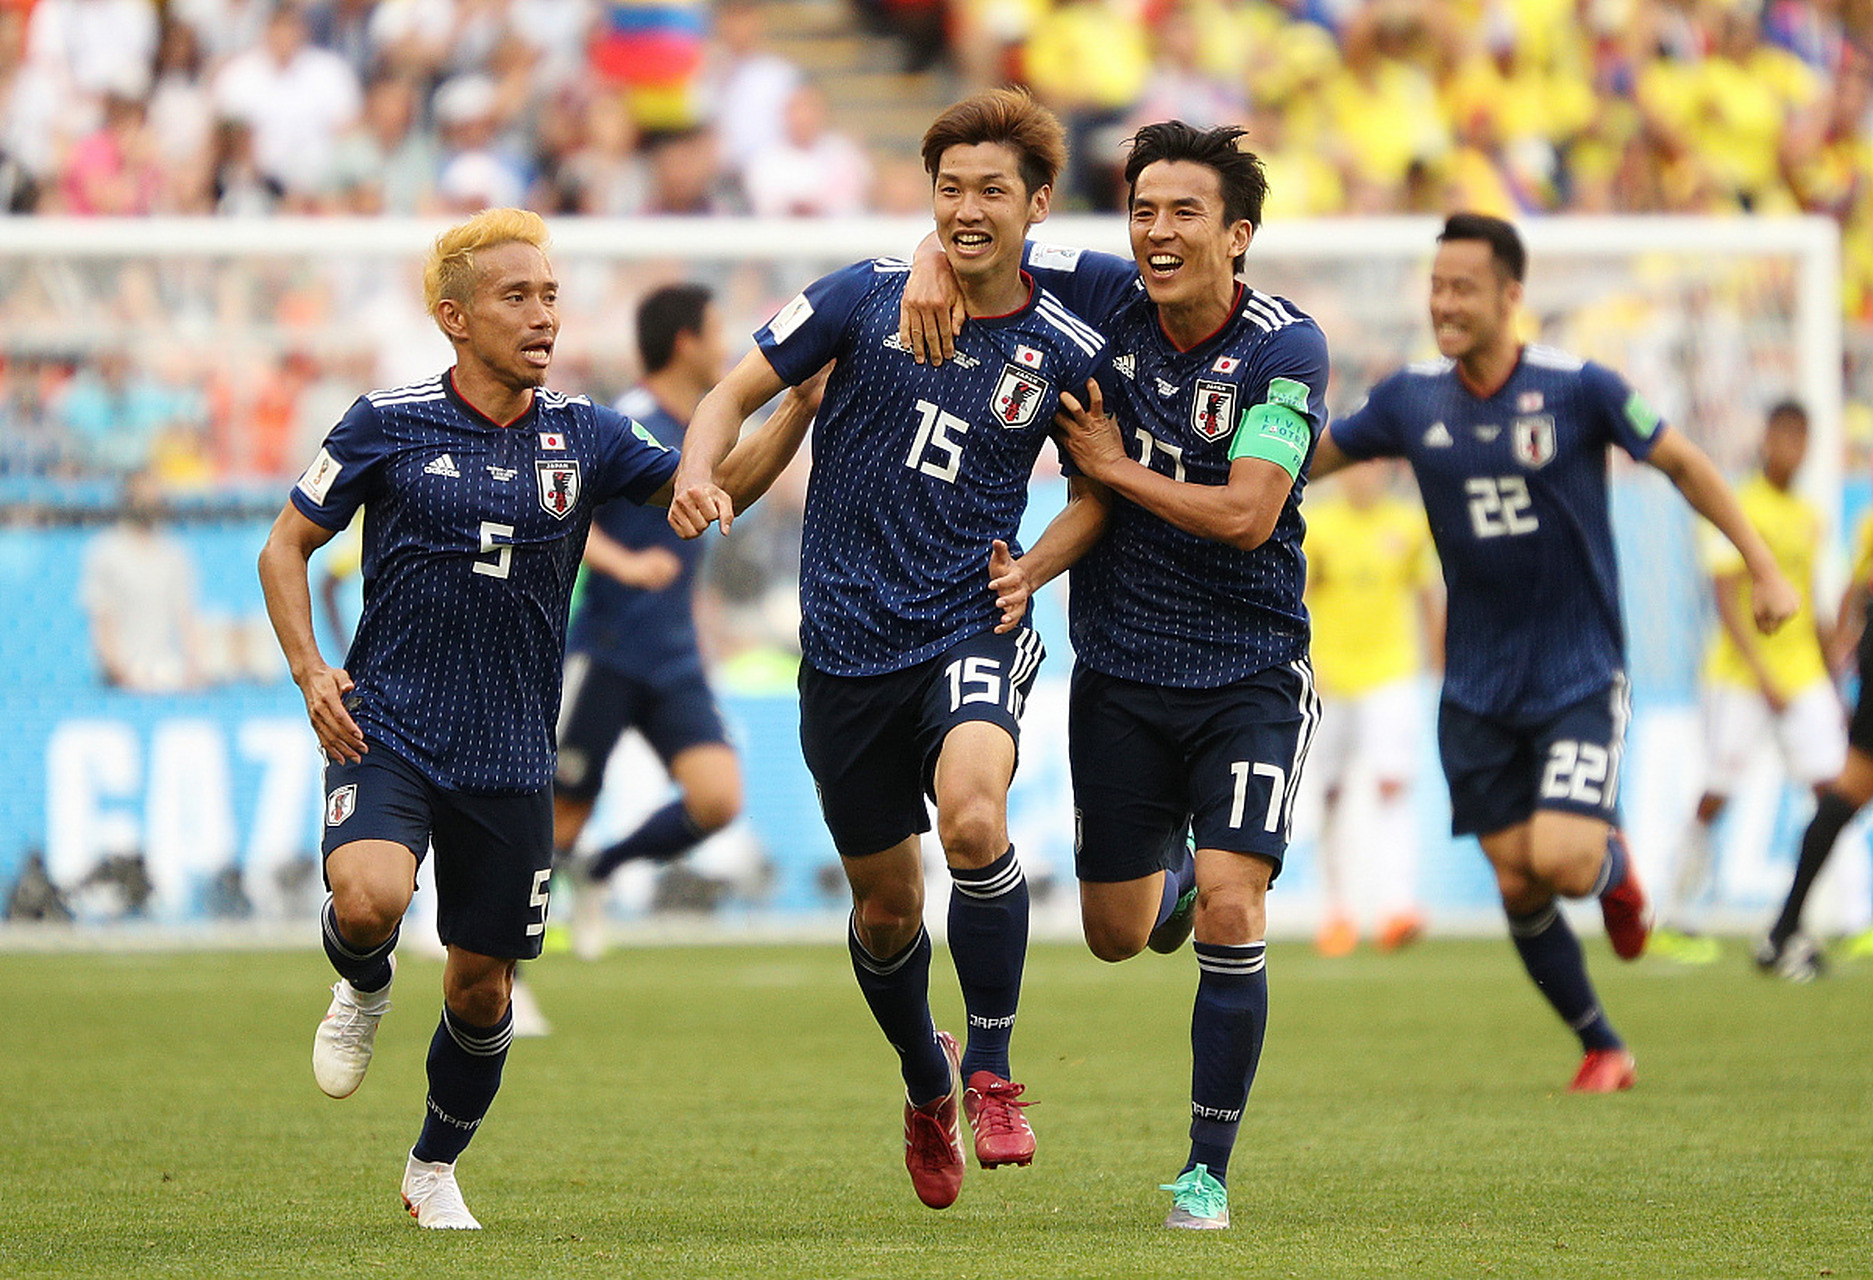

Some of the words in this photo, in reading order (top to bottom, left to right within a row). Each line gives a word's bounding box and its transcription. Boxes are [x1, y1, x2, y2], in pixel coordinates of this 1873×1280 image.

[424, 466, 461, 479] adidas
[905, 399, 970, 485] 15
[1464, 475, 1539, 539] 22
[472, 521, 514, 579] 5
[944, 656, 1001, 713] 15
[1229, 761, 1285, 832] 17
[1541, 739, 1609, 806] 22
[526, 868, 552, 936] 5
[970, 1014, 1016, 1030] JAPAN
[428, 1095, 482, 1130] JAPAN
